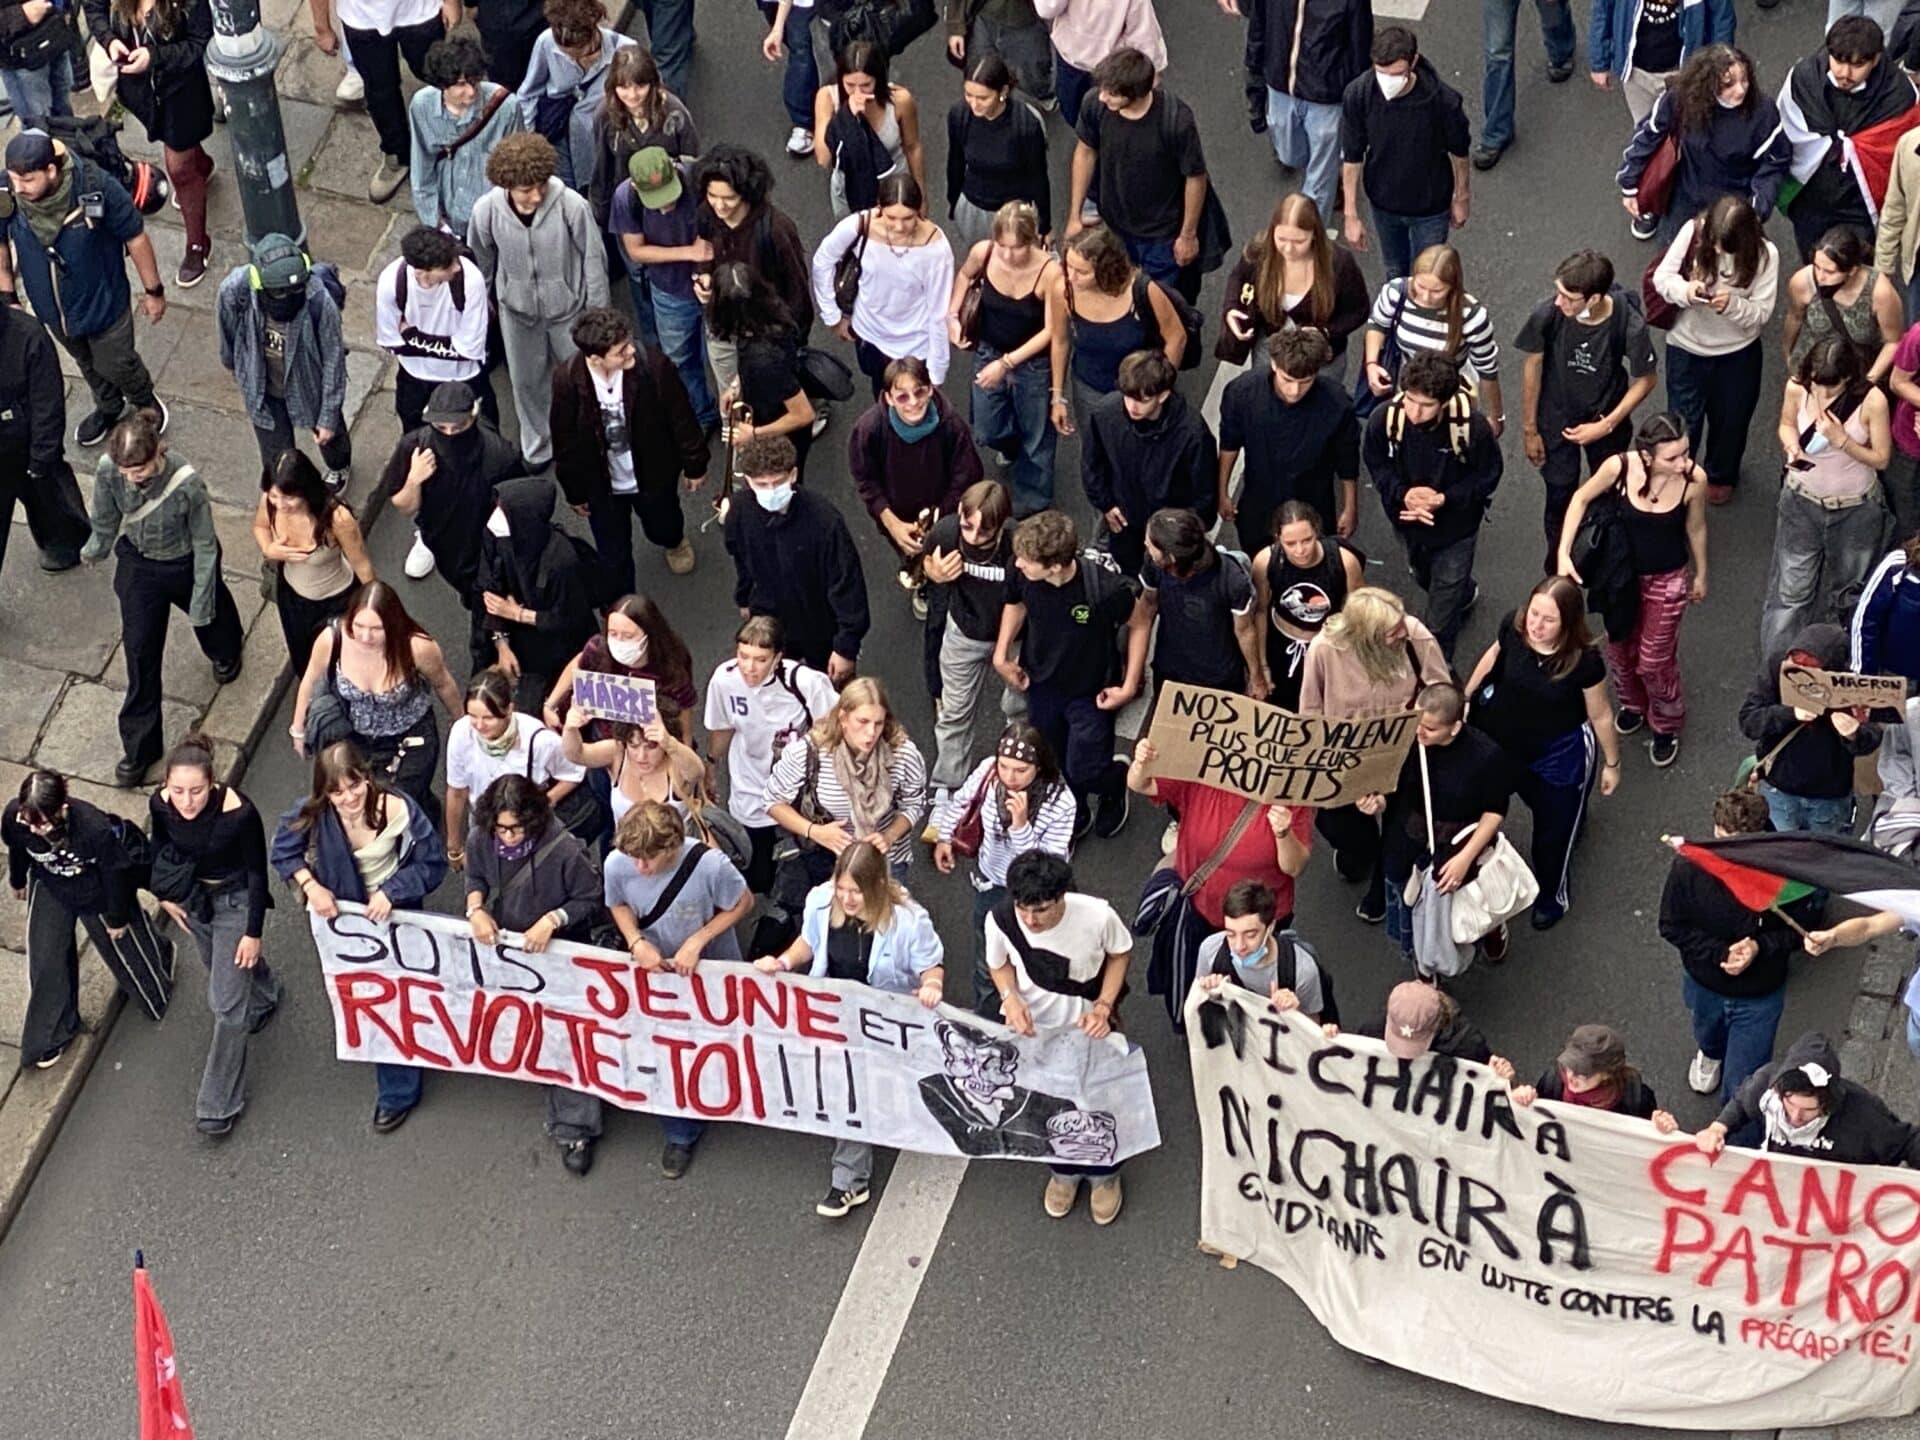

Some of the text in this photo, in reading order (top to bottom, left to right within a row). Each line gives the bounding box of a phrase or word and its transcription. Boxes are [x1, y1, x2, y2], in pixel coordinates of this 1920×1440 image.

[575, 677, 655, 719] MARRE
[730, 695, 748, 716] 15
[1831, 676, 1901, 690] MACRON
[1172, 690, 1417, 749] NOS VIES VALENT
[1190, 722, 1362, 771] PLUS QUE LEURS
[1198, 746, 1342, 802] PROFITS
[327, 912, 924, 1050] SOIS JEUNE ET
[1533, 1106, 1571, 1162] À
[1536, 1171, 1592, 1270] À
[1653, 1206, 1920, 1325] PATRO
[1418, 1238, 1470, 1272] EN
[1560, 1288, 1675, 1323] CONTRE
[1692, 1304, 1726, 1345] LA
